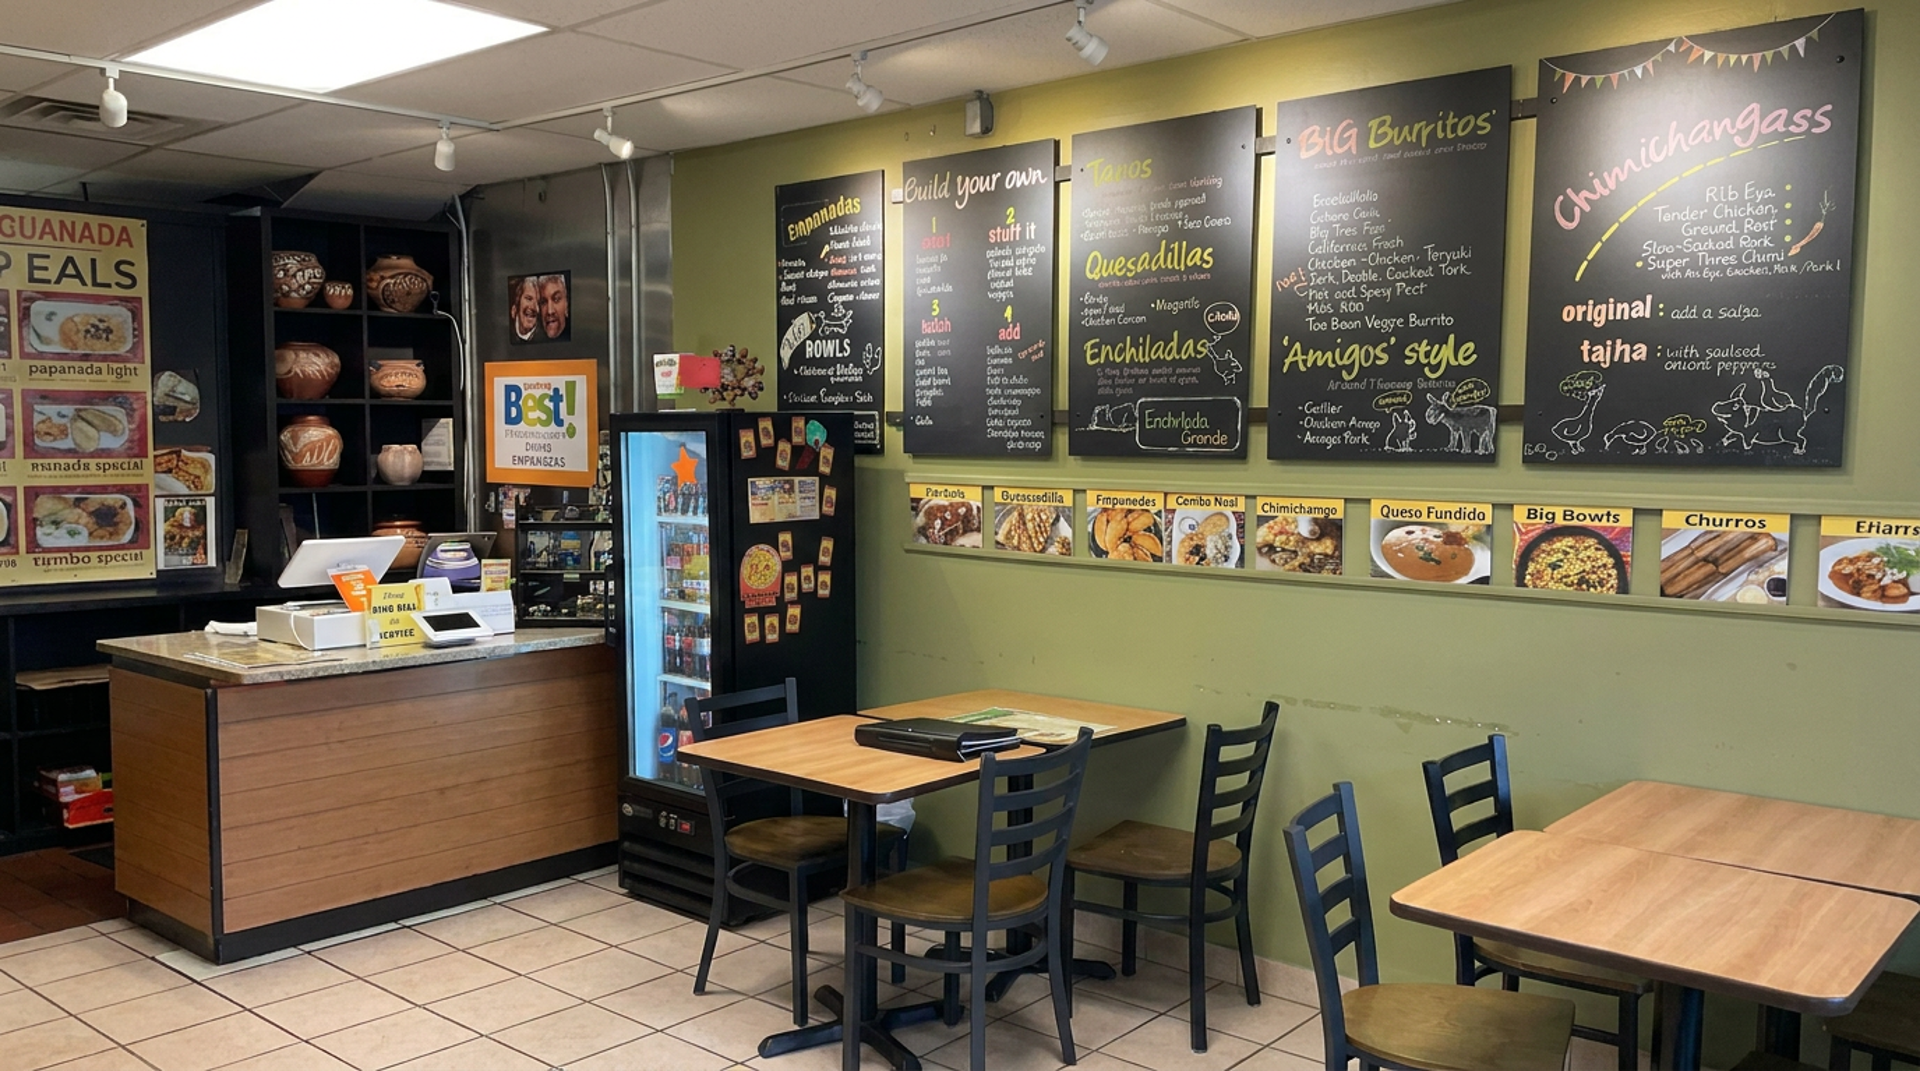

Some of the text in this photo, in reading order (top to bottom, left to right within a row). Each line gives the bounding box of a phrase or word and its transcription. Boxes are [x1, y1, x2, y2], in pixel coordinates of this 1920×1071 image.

[955, 172, 1001, 210] your
[1005, 167, 1048, 189] own
[1006, 206, 1015, 225] 2
[1653, 204, 1708, 223] Tender
[1026, 222, 1036, 241] it
[1085, 239, 1214, 281] Quesadillas
[931, 299, 940, 316] 3
[1562, 293, 1653, 328] original
[1670, 304, 1698, 319] add
[1408, 313, 1455, 328] Burrito
[998, 322, 1021, 341] add
[805, 338, 851, 359] ROWLS
[1084, 330, 1209, 366] Enchiladas
[1404, 333, 1477, 379] style
[1380, 504, 1422, 520] Queso
[1526, 507, 1556, 524] Big
[1685, 513, 1767, 529] Churros
